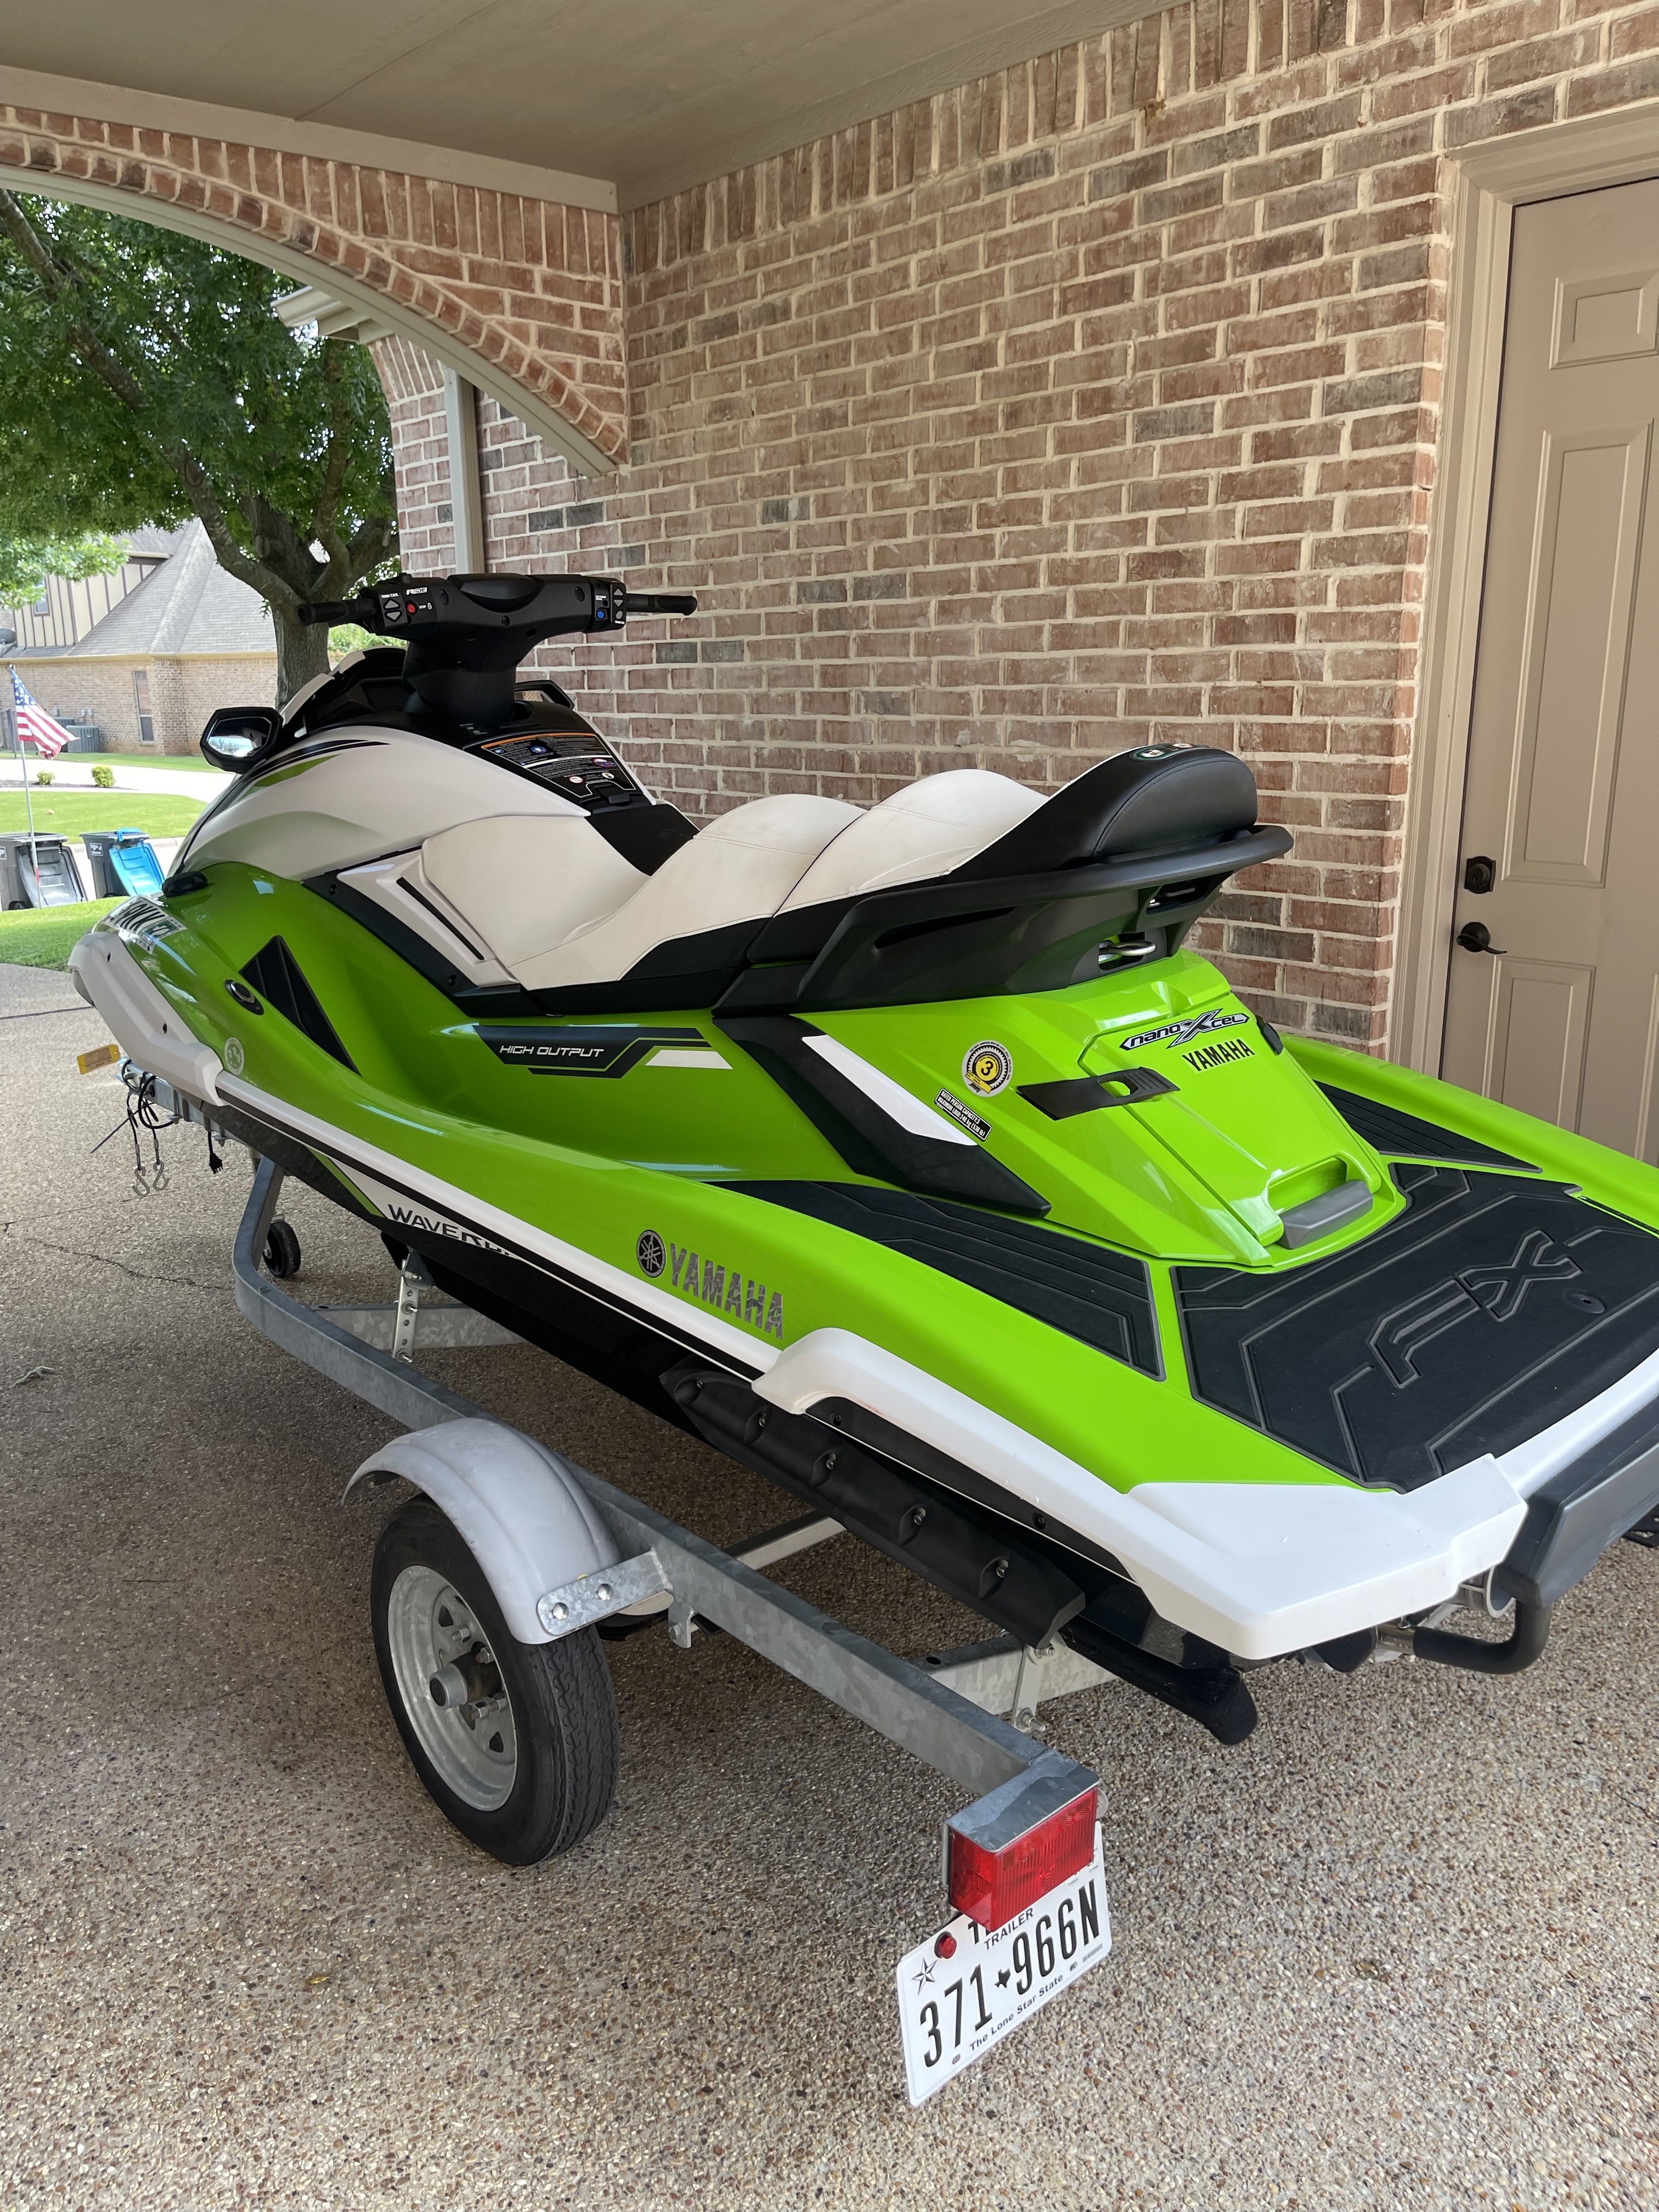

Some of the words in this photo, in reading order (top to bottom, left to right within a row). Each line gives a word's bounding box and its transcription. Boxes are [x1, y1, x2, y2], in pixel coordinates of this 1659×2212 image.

[500, 1045, 534, 1054] HIGH
[537, 1046, 604, 1057] OUTPUT
[1181, 1039, 1255, 1071] YAMAHA
[981, 1060, 994, 1076] 3
[938, 1096, 953, 1111] MAXIMUM
[940, 1091, 952, 1102] RATED
[950, 1098, 963, 1111] PERSON
[670, 1243, 783, 1340] YAMAHA
[984, 1907, 1034, 1950] TRAILER
[970, 2033, 988, 2051] The
[991, 2012, 1014, 2035] Lone
[1017, 1996, 1036, 2015] Star
[1039, 1974, 1063, 1997] State
